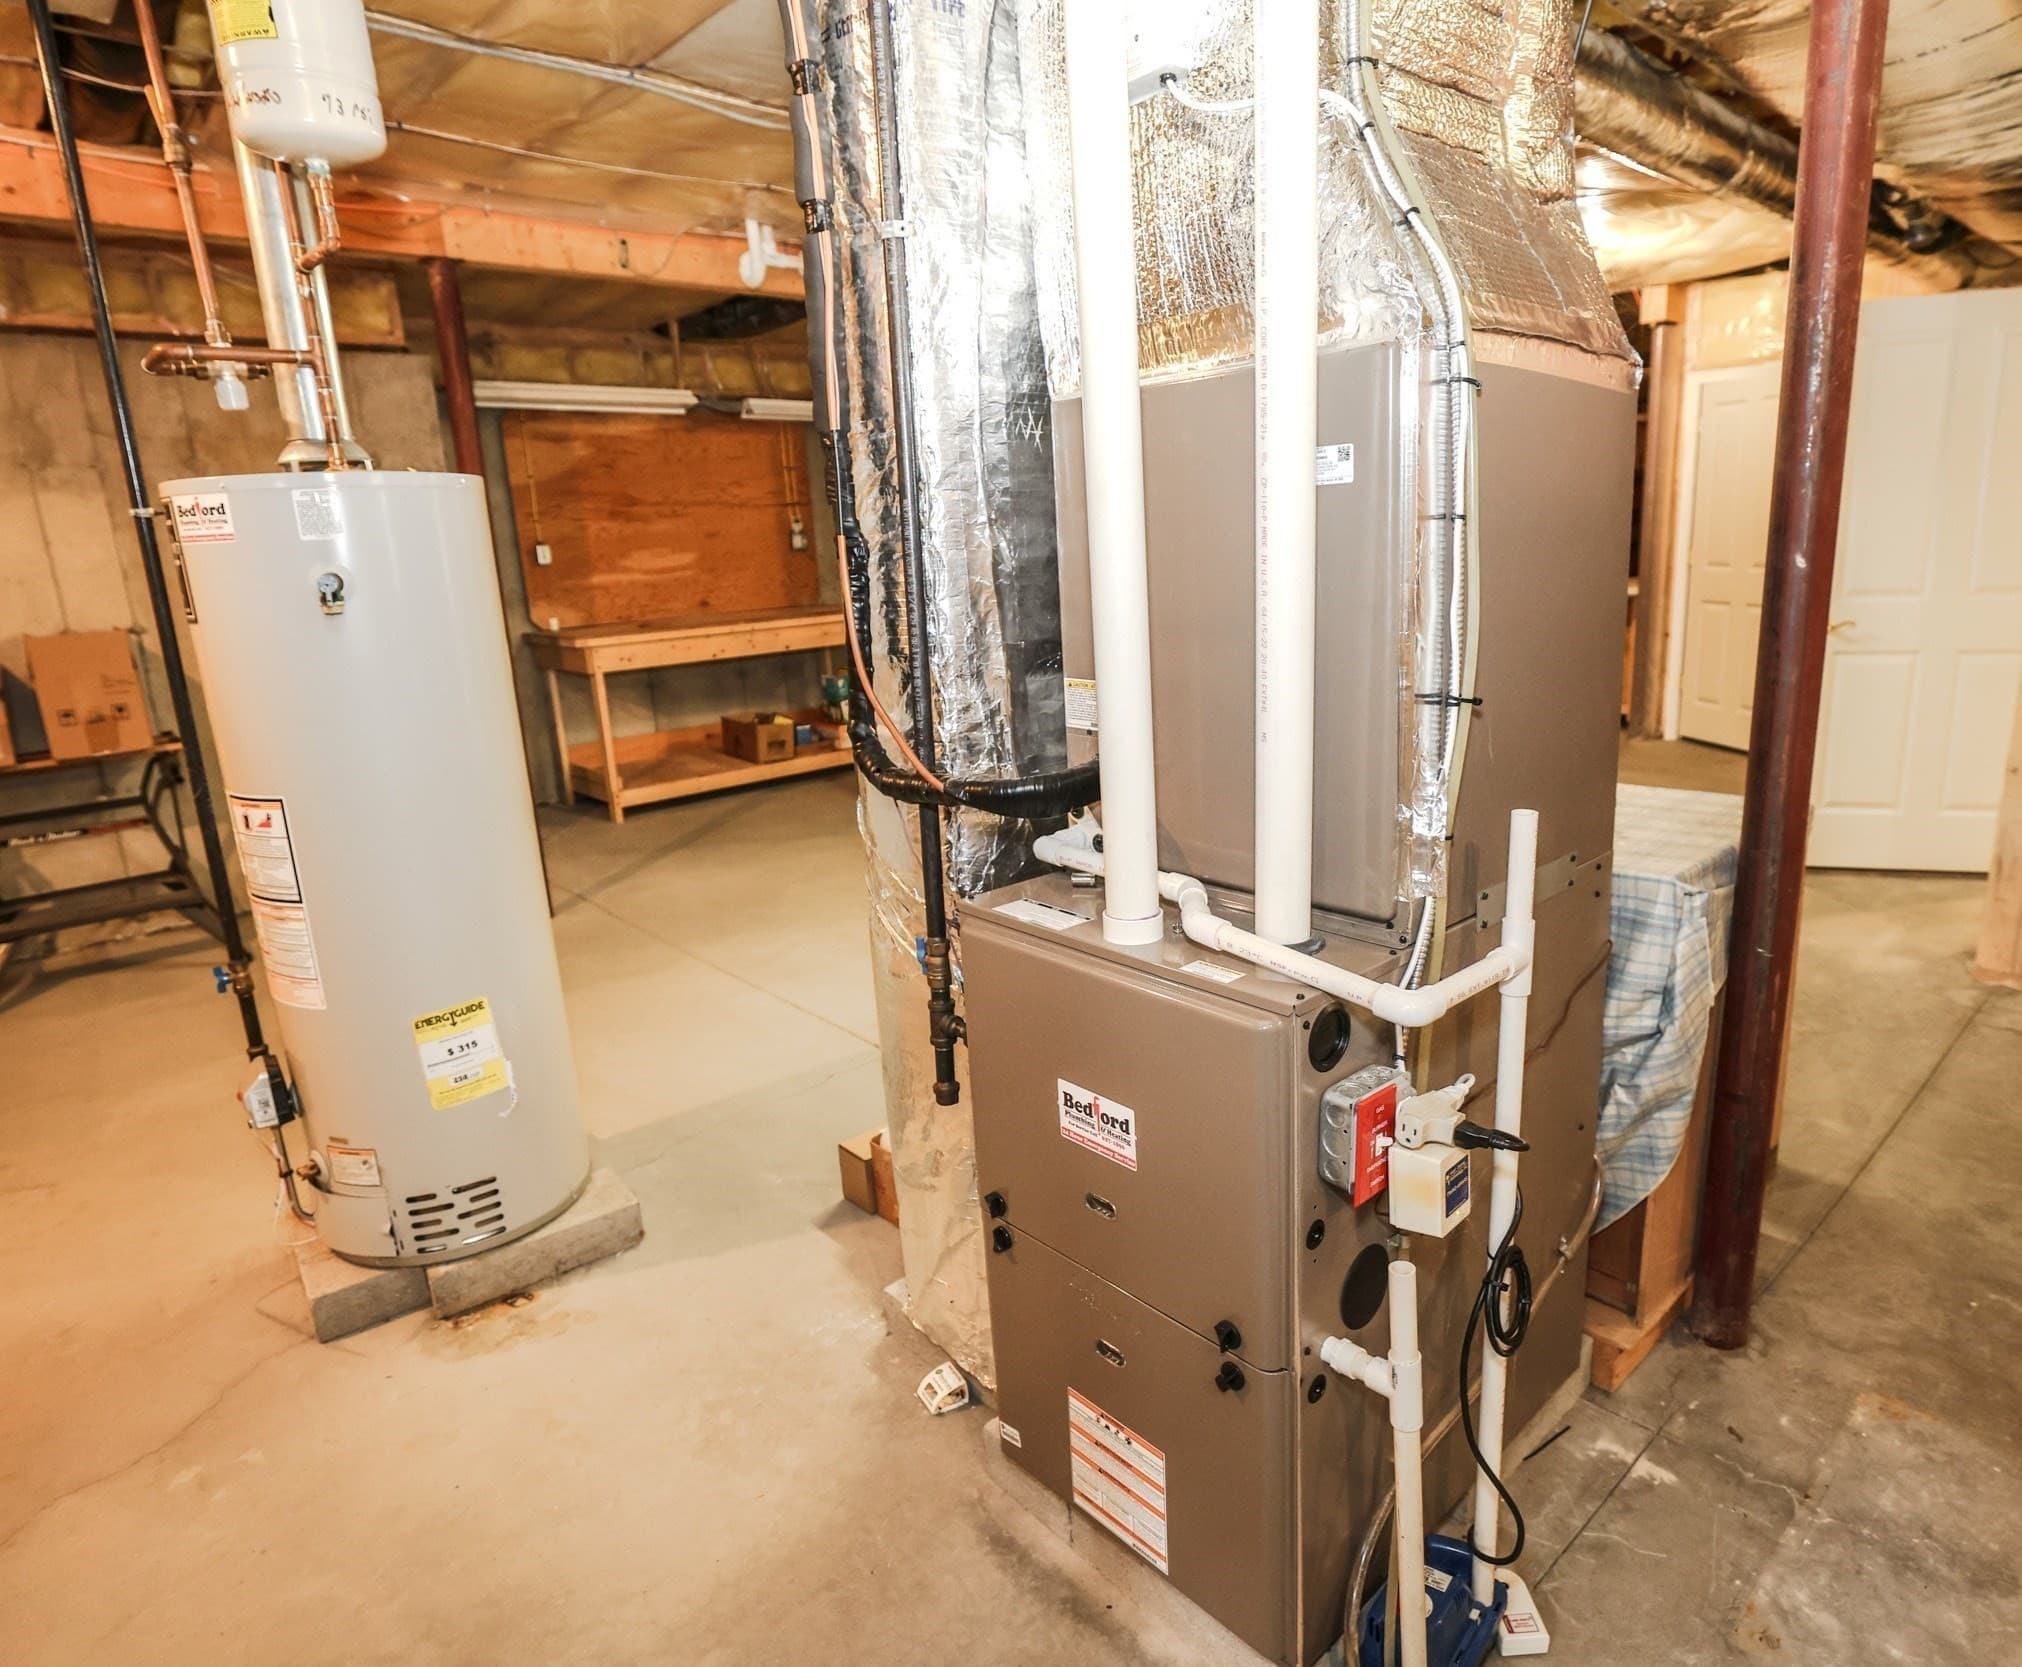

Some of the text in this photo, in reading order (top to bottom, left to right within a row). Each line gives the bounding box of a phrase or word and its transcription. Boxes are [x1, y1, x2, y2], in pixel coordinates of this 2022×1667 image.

[456, 1040, 479, 1053] 315
[1062, 1090, 1132, 1136] Bedford
[1106, 1127, 1132, 1147] Heating
